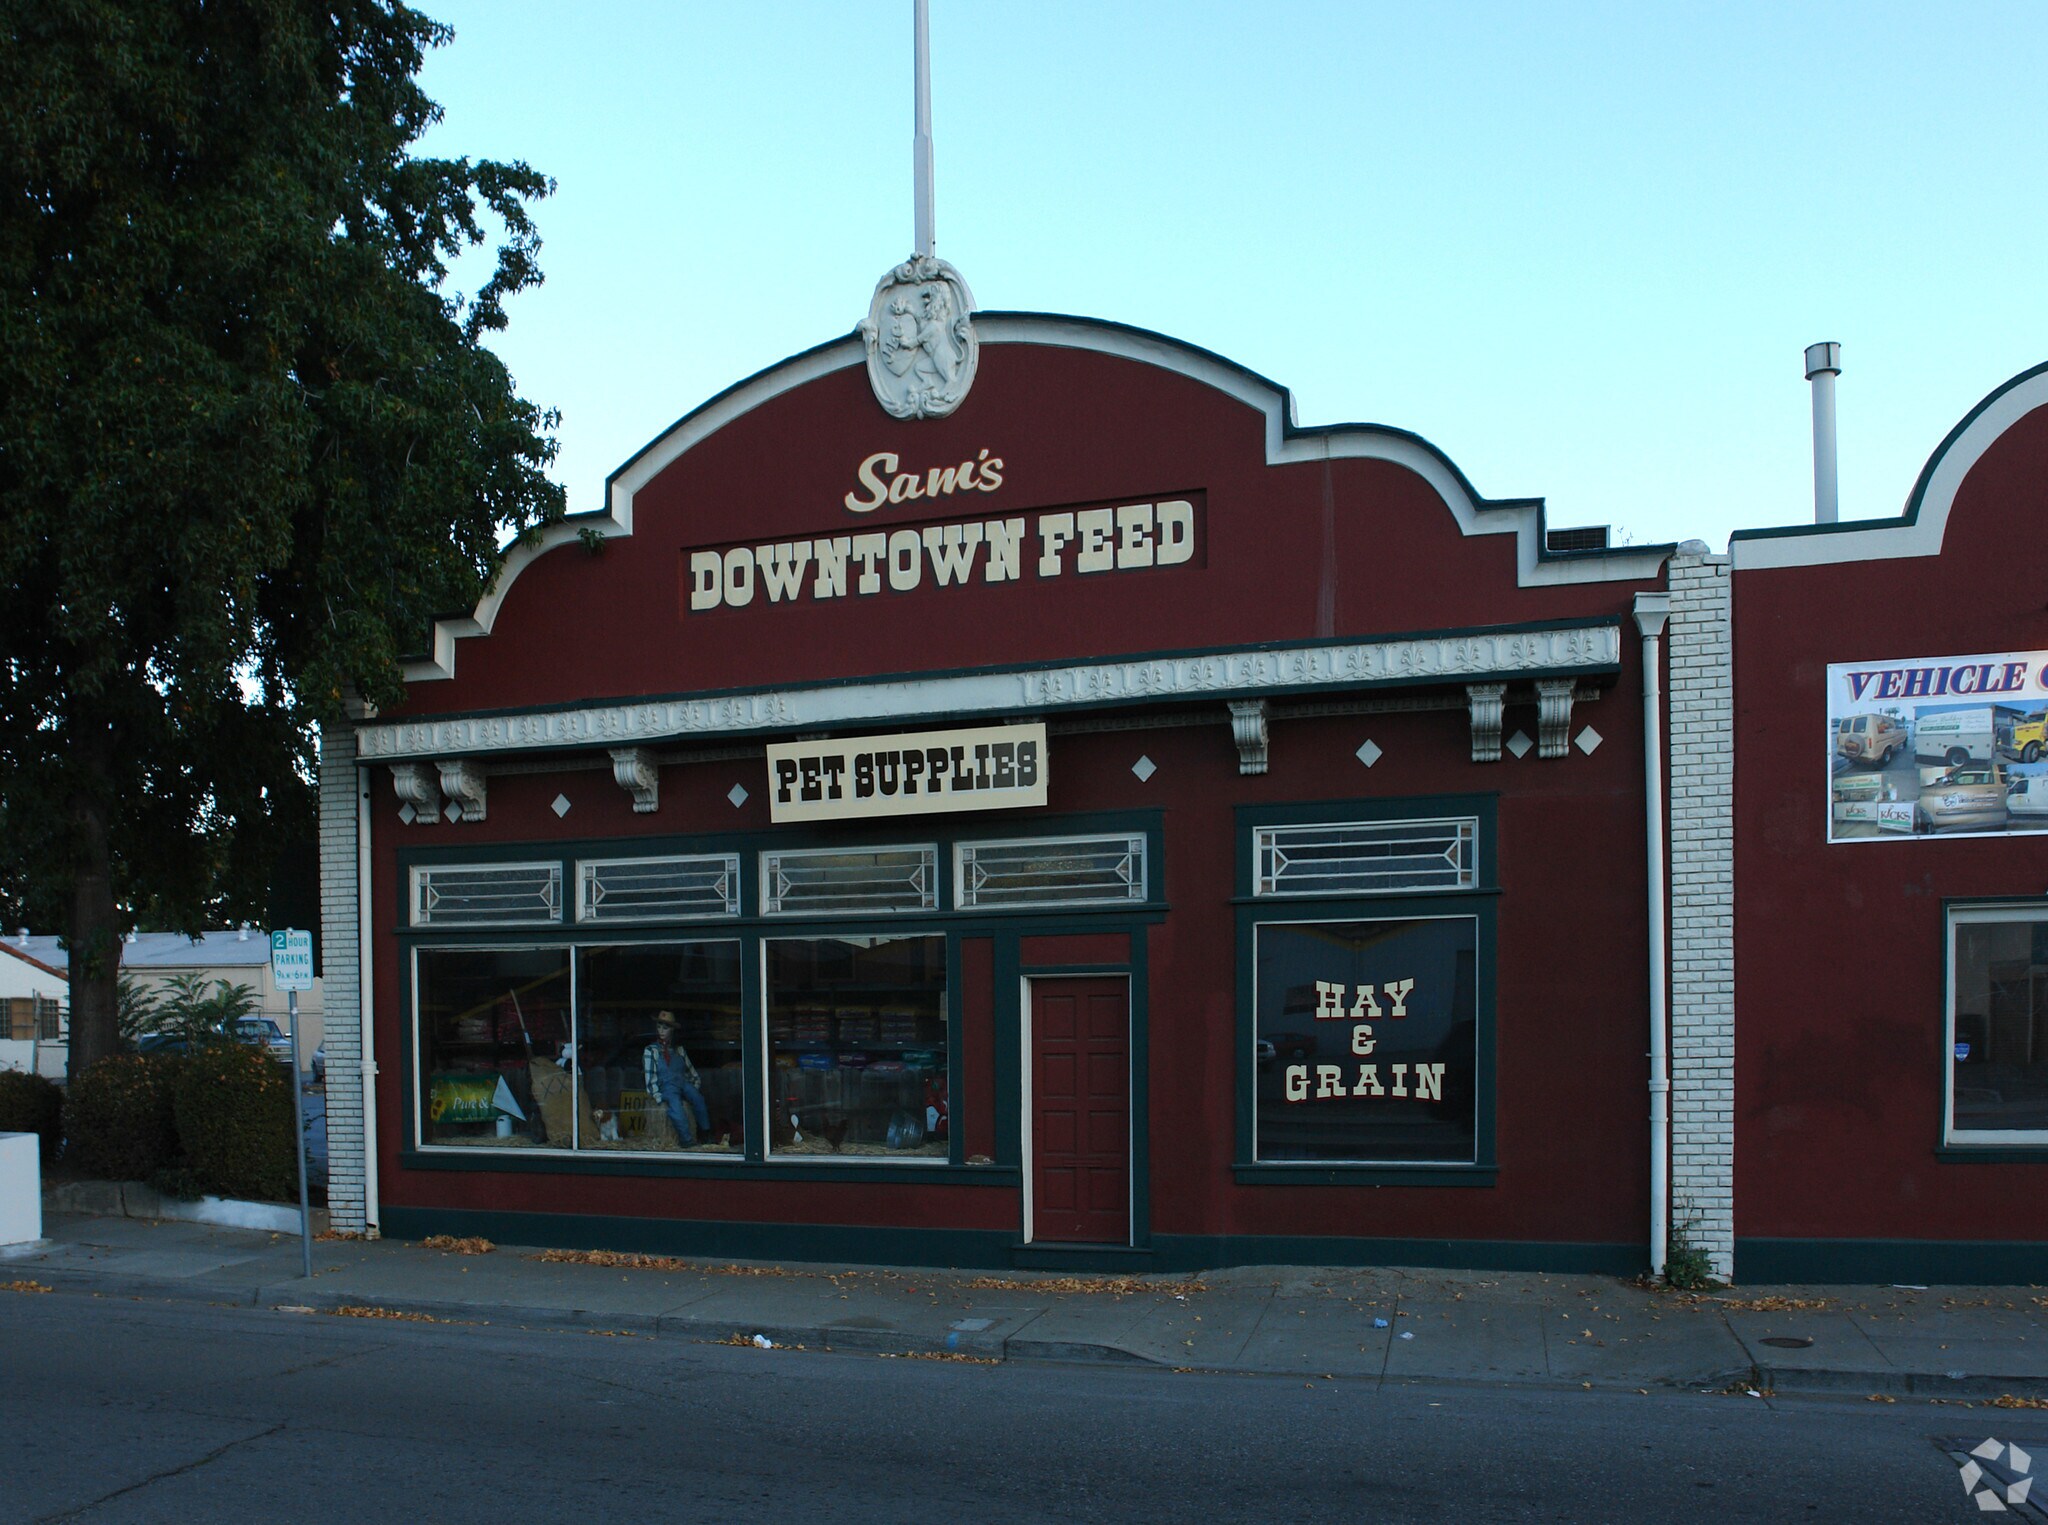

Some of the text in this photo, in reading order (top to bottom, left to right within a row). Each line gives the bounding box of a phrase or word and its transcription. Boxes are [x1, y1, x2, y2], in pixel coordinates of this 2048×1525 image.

[845, 449, 1004, 513] Sam's
[690, 499, 1195, 611] DOWNTOWN FEED
[1847, 662, 2028, 701] VEHICLE
[775, 740, 1038, 803] PET SUPPLIES
[275, 934, 309, 948] 2 HOUR
[275, 953, 309, 965] PARKING
[1315, 978, 1414, 1019] HAY
[1351, 1024, 1377, 1056] &
[1285, 1062, 1446, 1102] GRAIN
